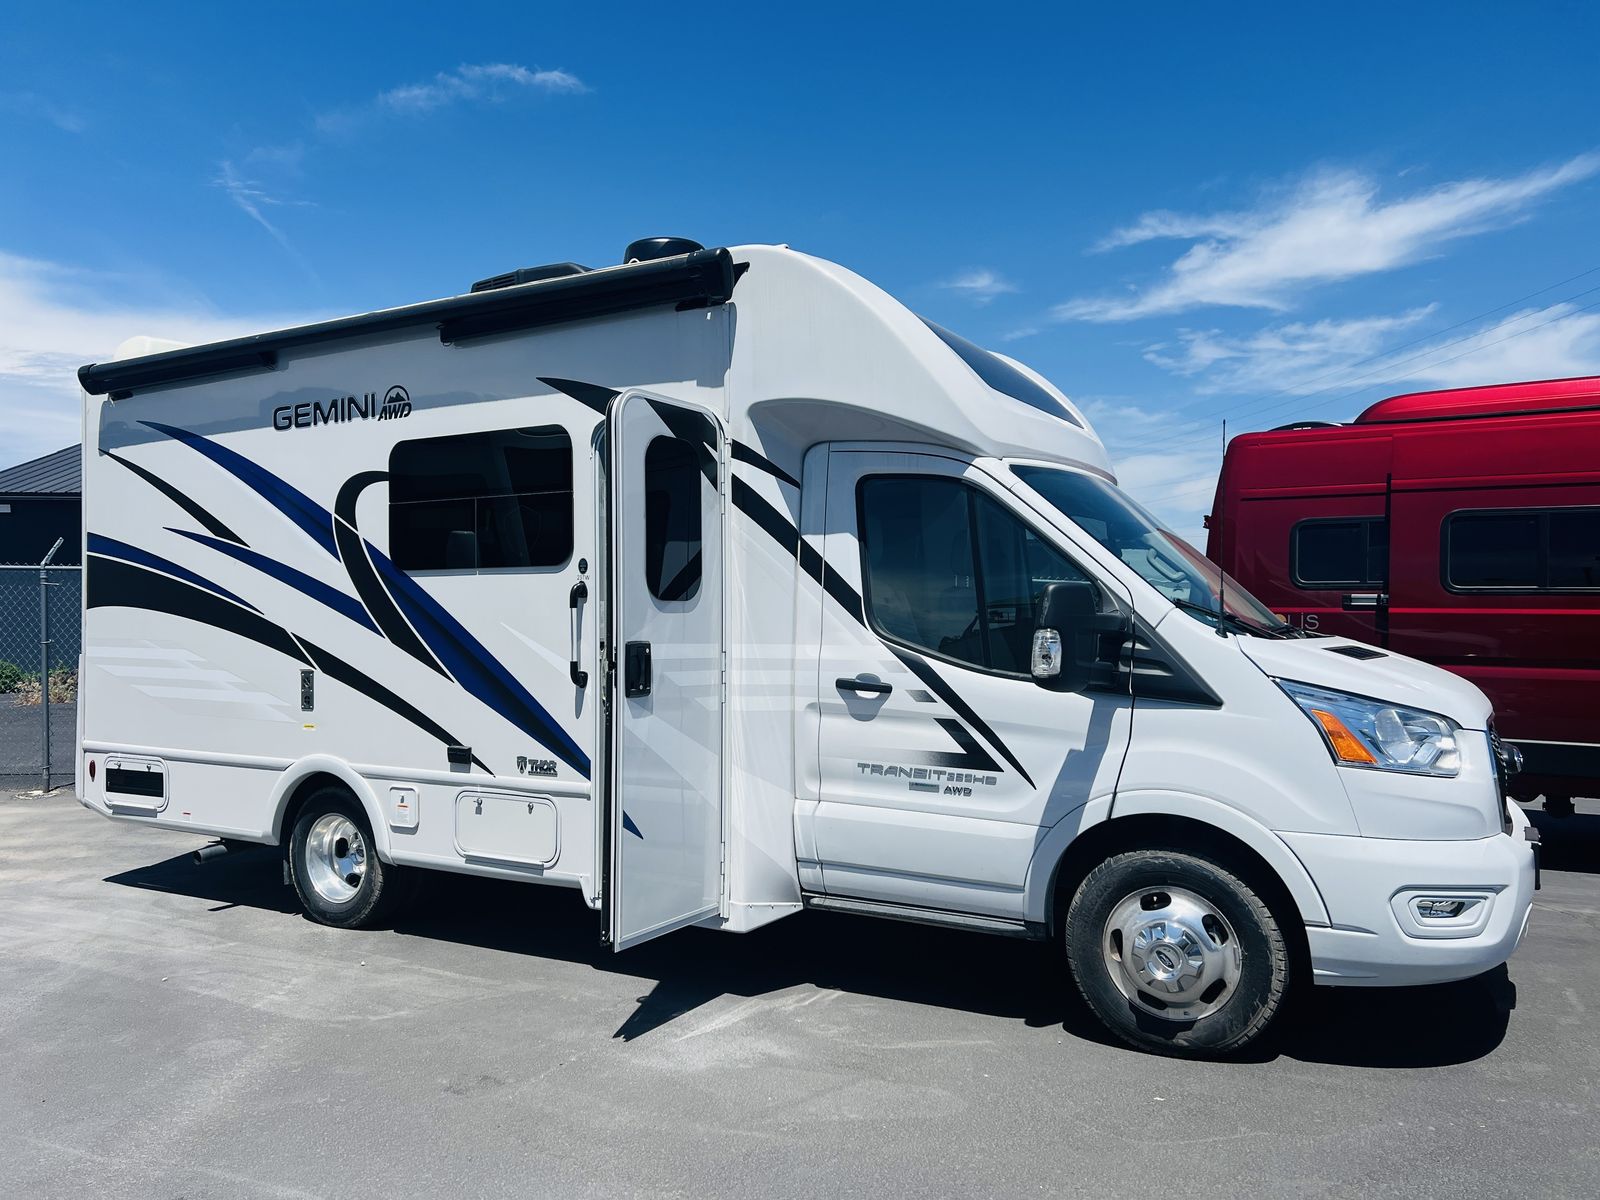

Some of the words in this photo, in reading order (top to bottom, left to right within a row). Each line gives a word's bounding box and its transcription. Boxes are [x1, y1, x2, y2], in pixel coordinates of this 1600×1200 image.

[273, 393, 376, 431] GEMINI
[378, 402, 412, 421] AWD
[528, 759, 557, 772] THOR
